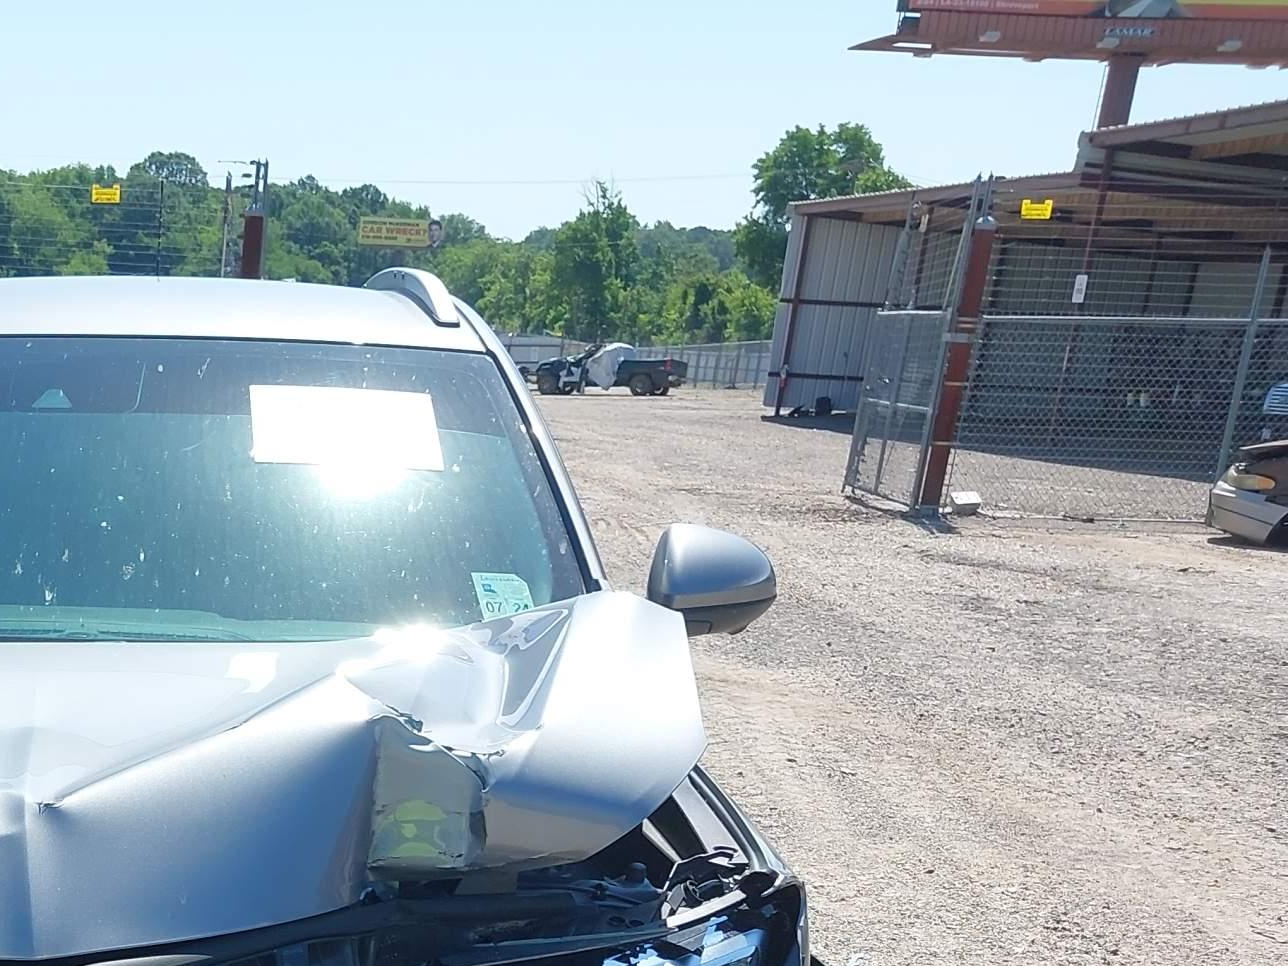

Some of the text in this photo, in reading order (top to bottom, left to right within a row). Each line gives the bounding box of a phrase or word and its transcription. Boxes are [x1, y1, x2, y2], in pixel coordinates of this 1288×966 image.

[1103, 27, 1153, 37] LAMAR
[361, 225, 383, 234] CAR
[485, 601, 503, 613] 07
